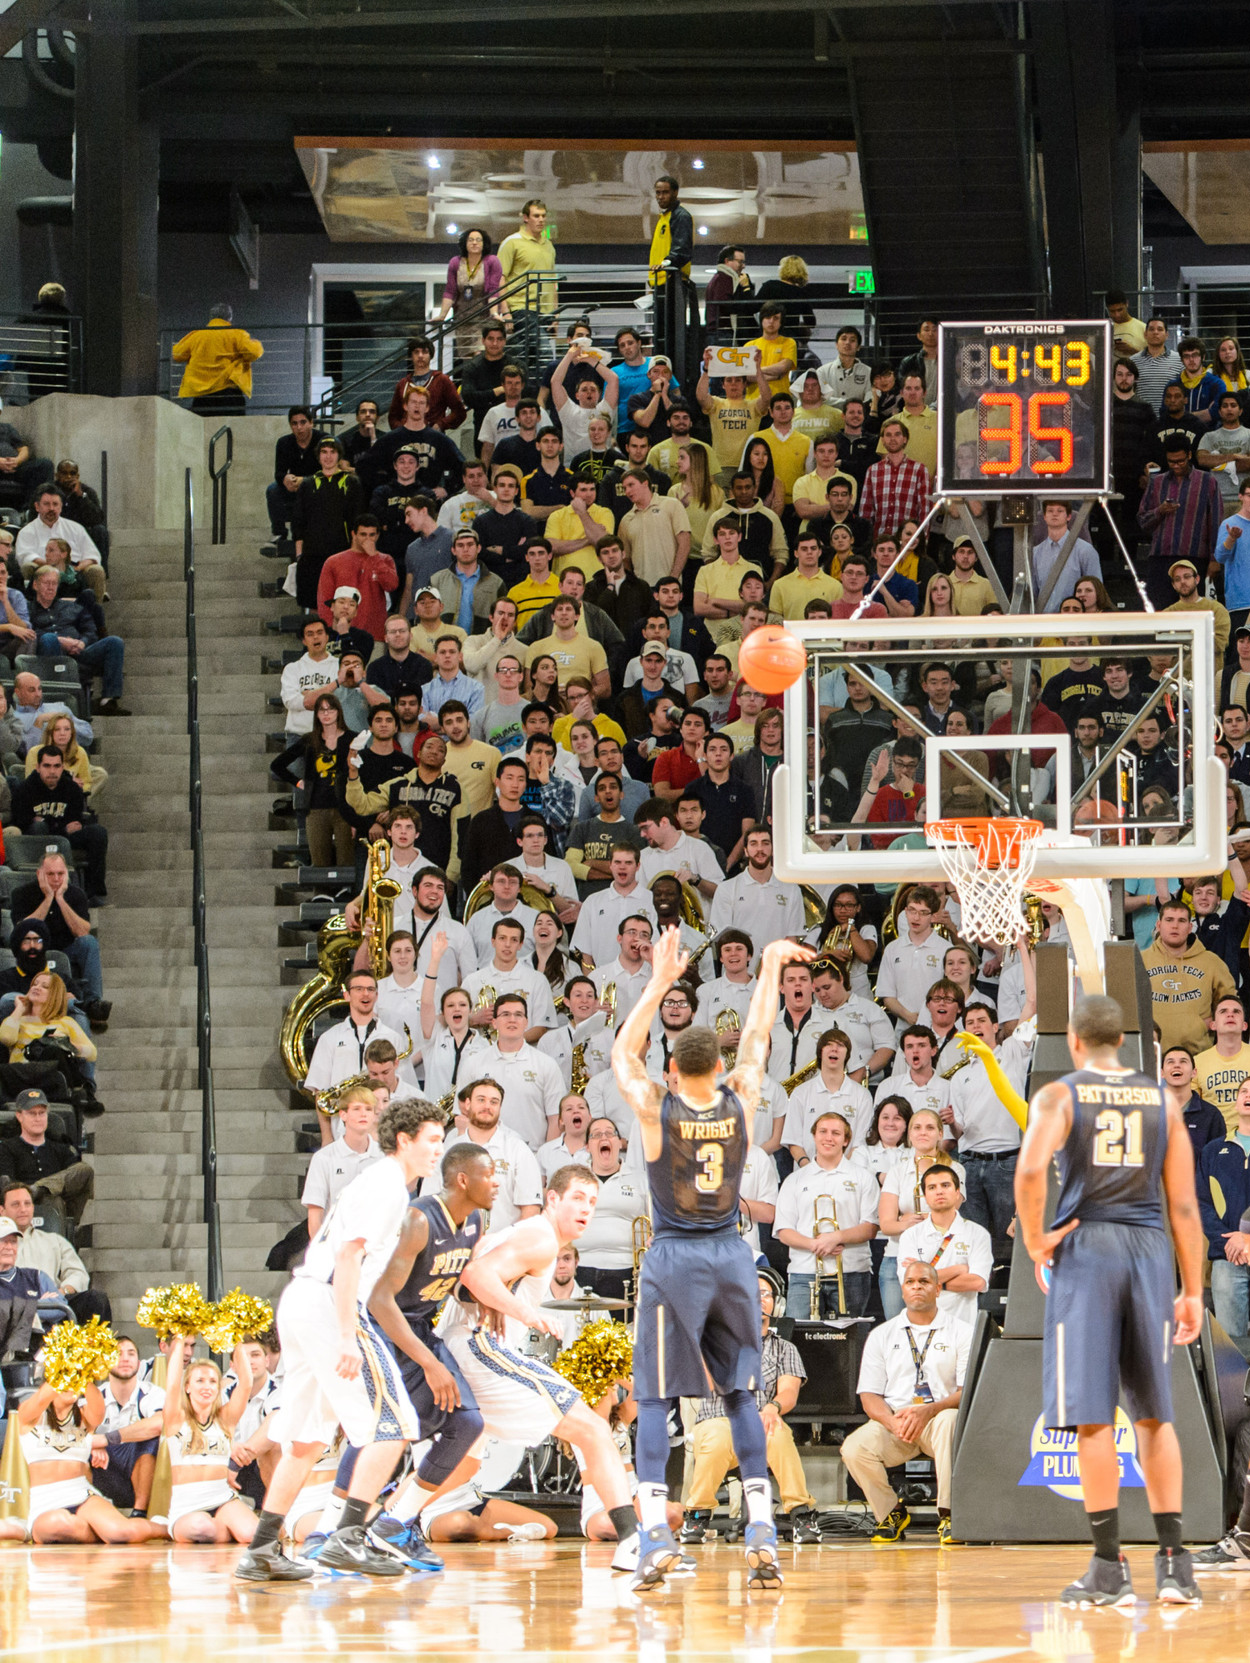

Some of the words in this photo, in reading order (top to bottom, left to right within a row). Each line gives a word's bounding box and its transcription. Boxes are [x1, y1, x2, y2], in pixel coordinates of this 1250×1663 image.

[856, 272, 875, 291] EX
[984, 325, 1065, 335] DAKTRONICS
[717, 348, 750, 367] GT
[989, 341, 1090, 386] 4:43
[719, 409, 752, 420] GEORGIA
[723, 420, 747, 430] TECH
[979, 392, 1073, 475] 35
[1061, 684, 1086, 701] GEORGIA
[1087, 684, 1102, 697] TECH
[428, 803, 446, 816] GT
[1148, 965, 1179, 979] EORGIA
[1182, 966, 1205, 979] TECH
[1163, 979, 1182, 992] GT
[1151, 991, 1174, 1003] LLOW
[1174, 988, 1202, 1003] JACKETS
[1075, 1085, 1161, 1105] PATTERSON
[1214, 1088, 1237, 1103] TEC
[698, 1111, 715, 1120] ACC
[679, 1117, 737, 1140] WRIGHT
[1093, 1110, 1145, 1167] 21
[696, 1142, 724, 1194] 3
[430, 1248, 472, 1276] PITT
[418, 1277, 458, 1302] 42
[805, 1333, 812, 1341] tc
[813, 1332, 848, 1341] electronic
[933, 1343, 948, 1352] GT
[379, 1422, 398, 1434] GT
[1039, 1425, 1128, 1449] Supr
